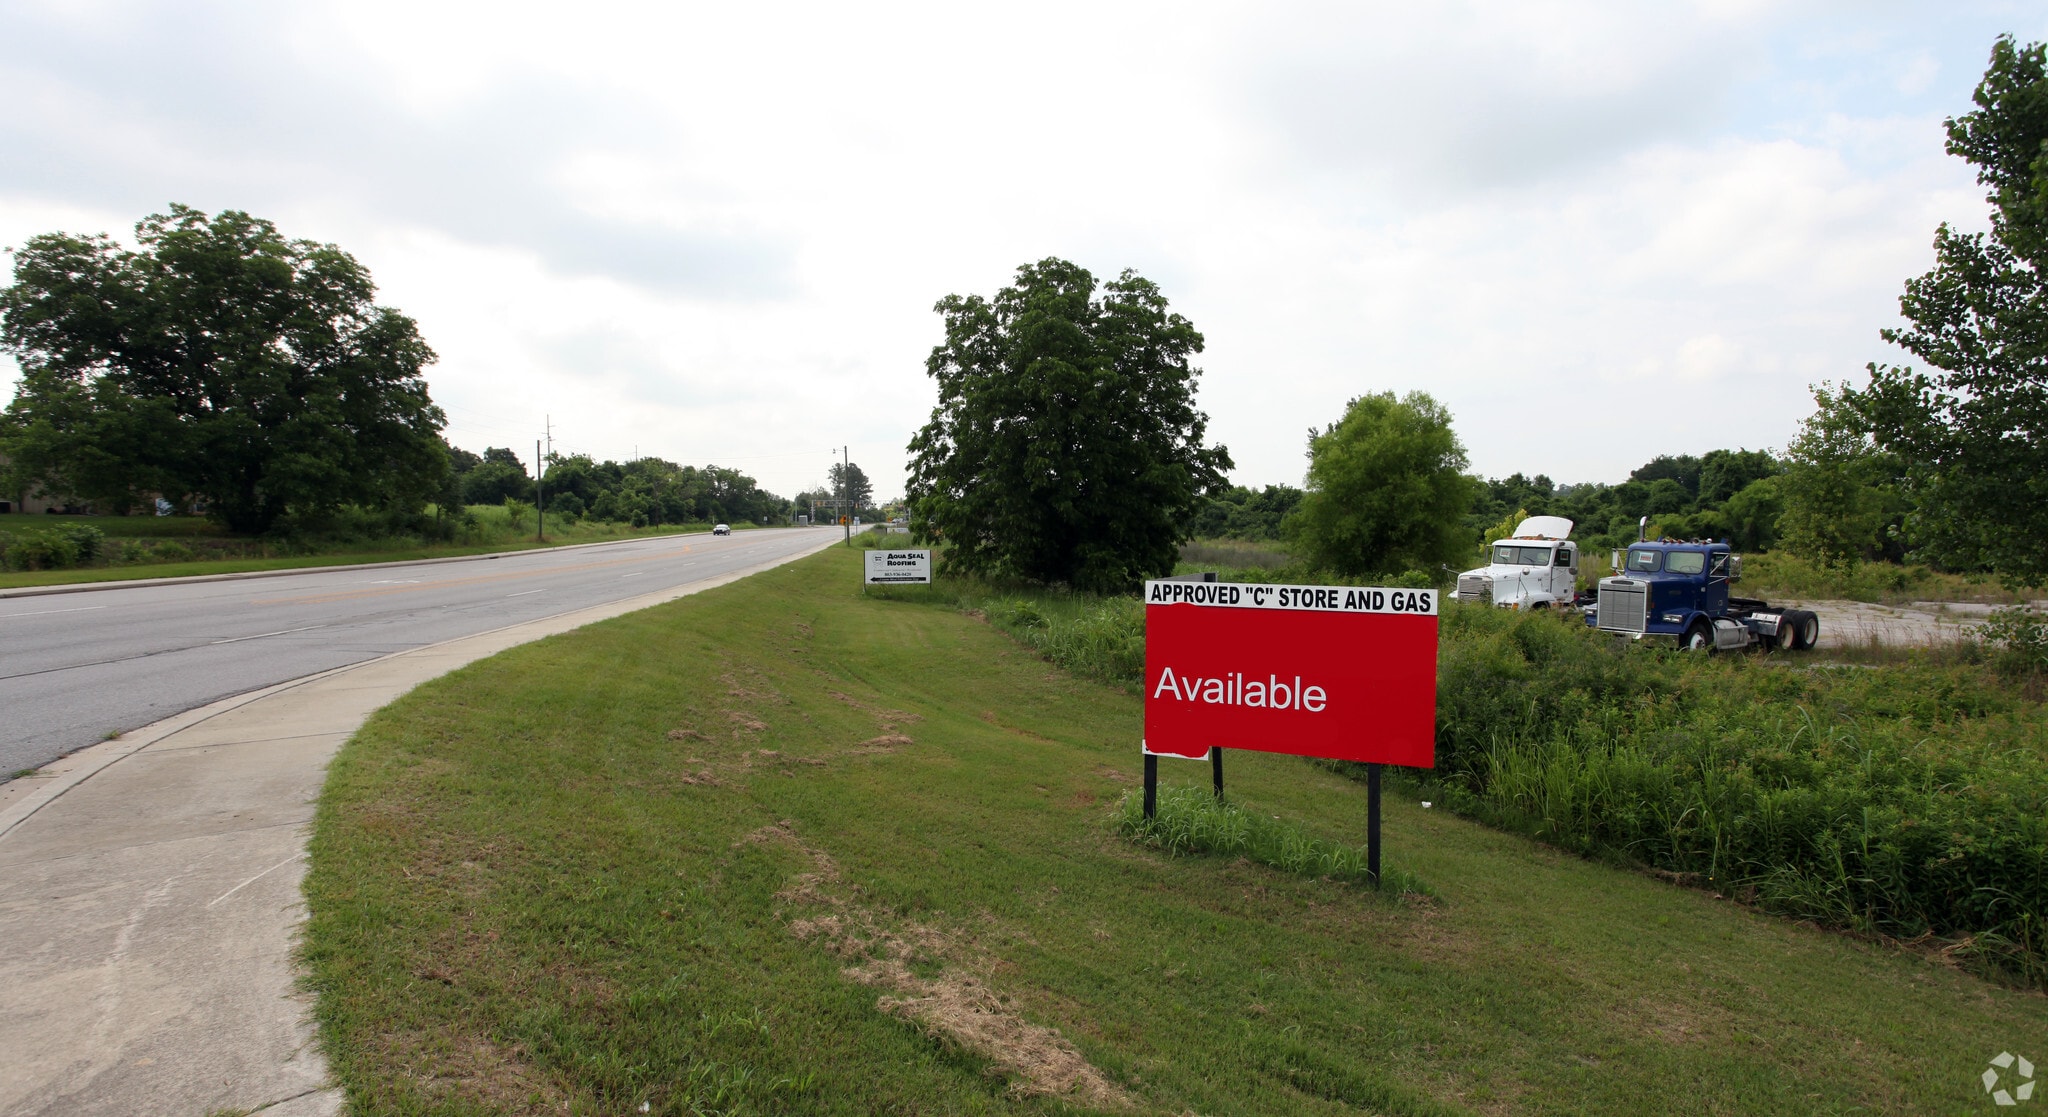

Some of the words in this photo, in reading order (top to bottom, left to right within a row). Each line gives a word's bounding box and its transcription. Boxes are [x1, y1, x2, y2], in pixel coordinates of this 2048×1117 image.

[1150, 584, 1240, 605] APPROVED
[1245, 587, 1273, 606] "C"
[1278, 588, 1339, 609] STORE
[1344, 590, 1385, 611] AND
[1390, 592, 1431, 613] GAS
[1153, 667, 1327, 713] Available
